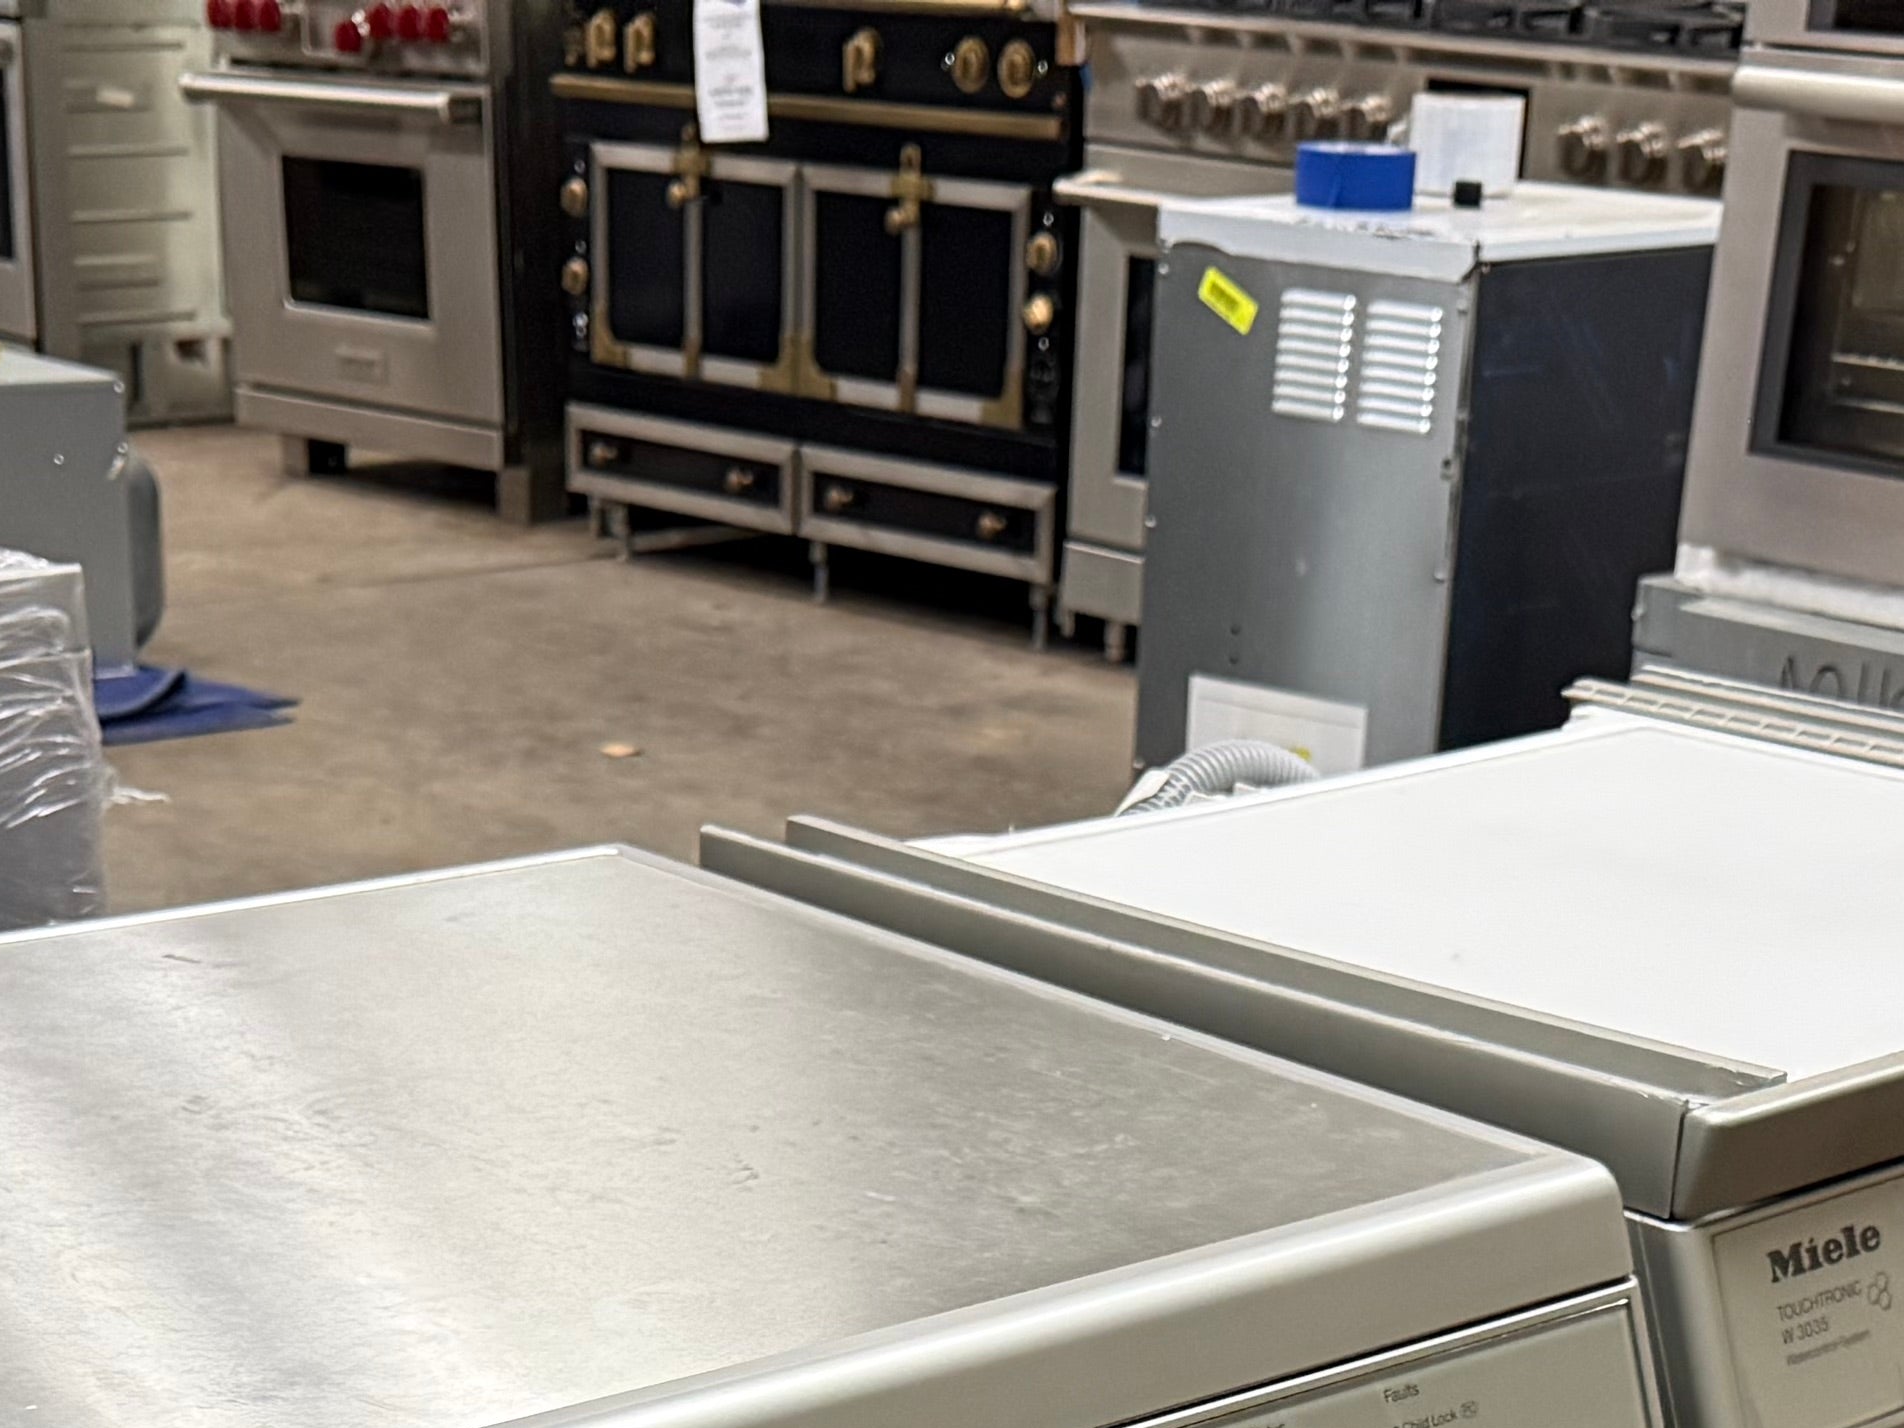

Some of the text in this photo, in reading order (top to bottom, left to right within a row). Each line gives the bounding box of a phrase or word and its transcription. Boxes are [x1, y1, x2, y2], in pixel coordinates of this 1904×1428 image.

[1766, 1224, 1881, 1284] Miele
[1777, 1280, 1863, 1321] TOUCHTRONIC
[1782, 1327, 1794, 1344] W
